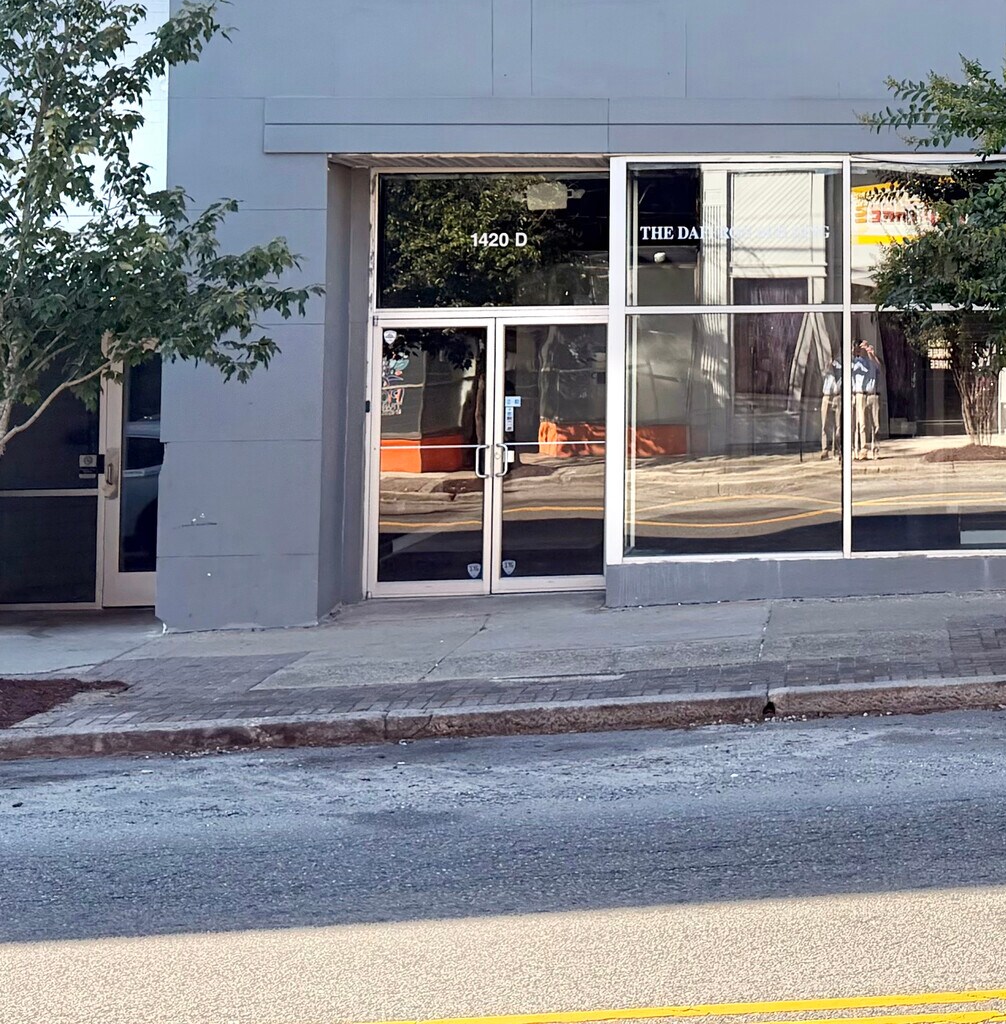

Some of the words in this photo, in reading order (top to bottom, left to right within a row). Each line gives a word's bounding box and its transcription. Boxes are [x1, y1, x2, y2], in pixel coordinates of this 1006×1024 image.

[470, 232, 509, 247] 1420
[515, 232, 528, 247] D
[640, 226, 674, 240] THE
